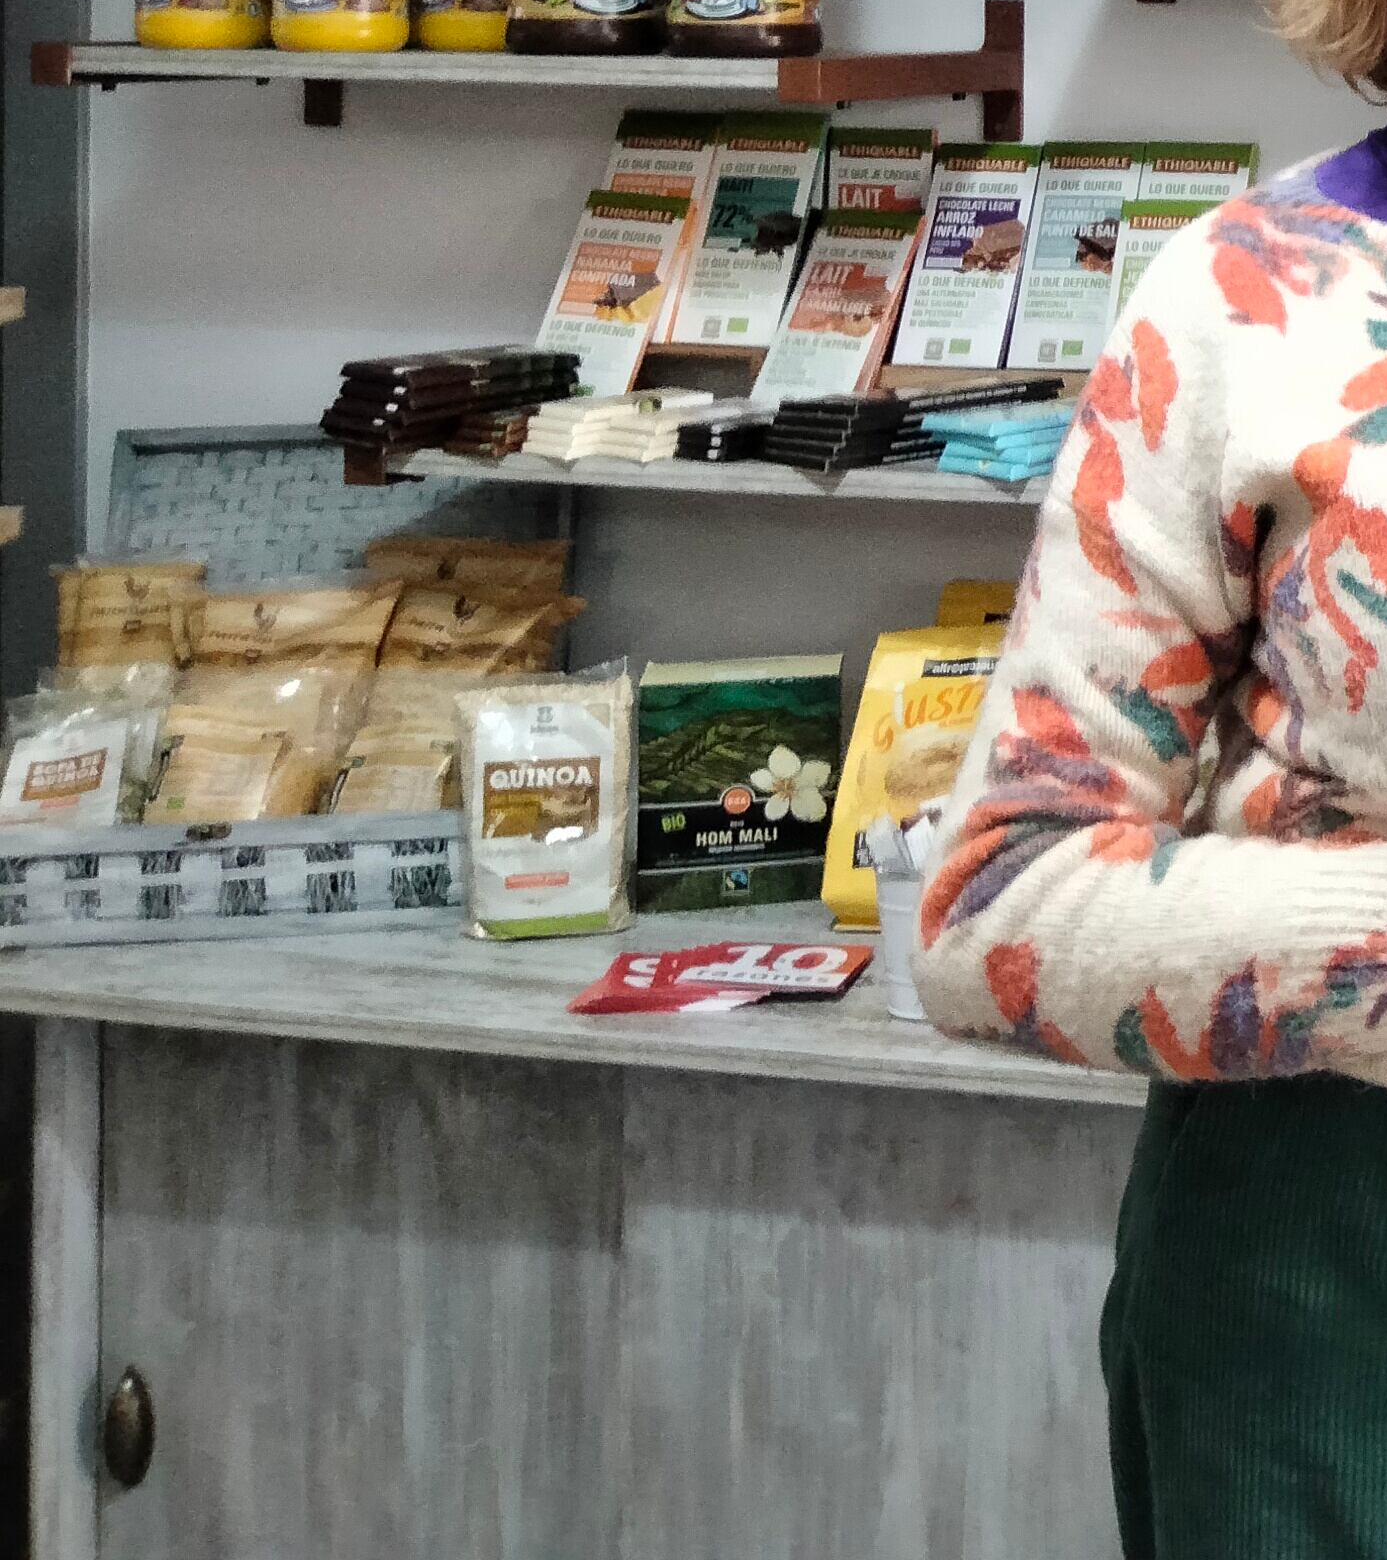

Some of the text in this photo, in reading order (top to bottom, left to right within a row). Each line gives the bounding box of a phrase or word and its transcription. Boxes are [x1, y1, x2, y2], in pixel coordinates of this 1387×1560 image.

[946, 159, 1027, 173] ETHIQUABLE
[1053, 155, 1133, 170] ETHIQUABLE
[1155, 159, 1237, 173] ETHIQUABLE
[840, 188, 883, 209] LAIT
[937, 199, 1017, 212] CHOCOLATE LECHE
[935, 211, 977, 224] ARROZ
[932, 225, 984, 238] INFLADO
[489, 764, 594, 790] QUINOA
[661, 810, 686, 833] BIO
[696, 827, 778, 847] HOM MALI
[722, 944, 849, 973] 10
